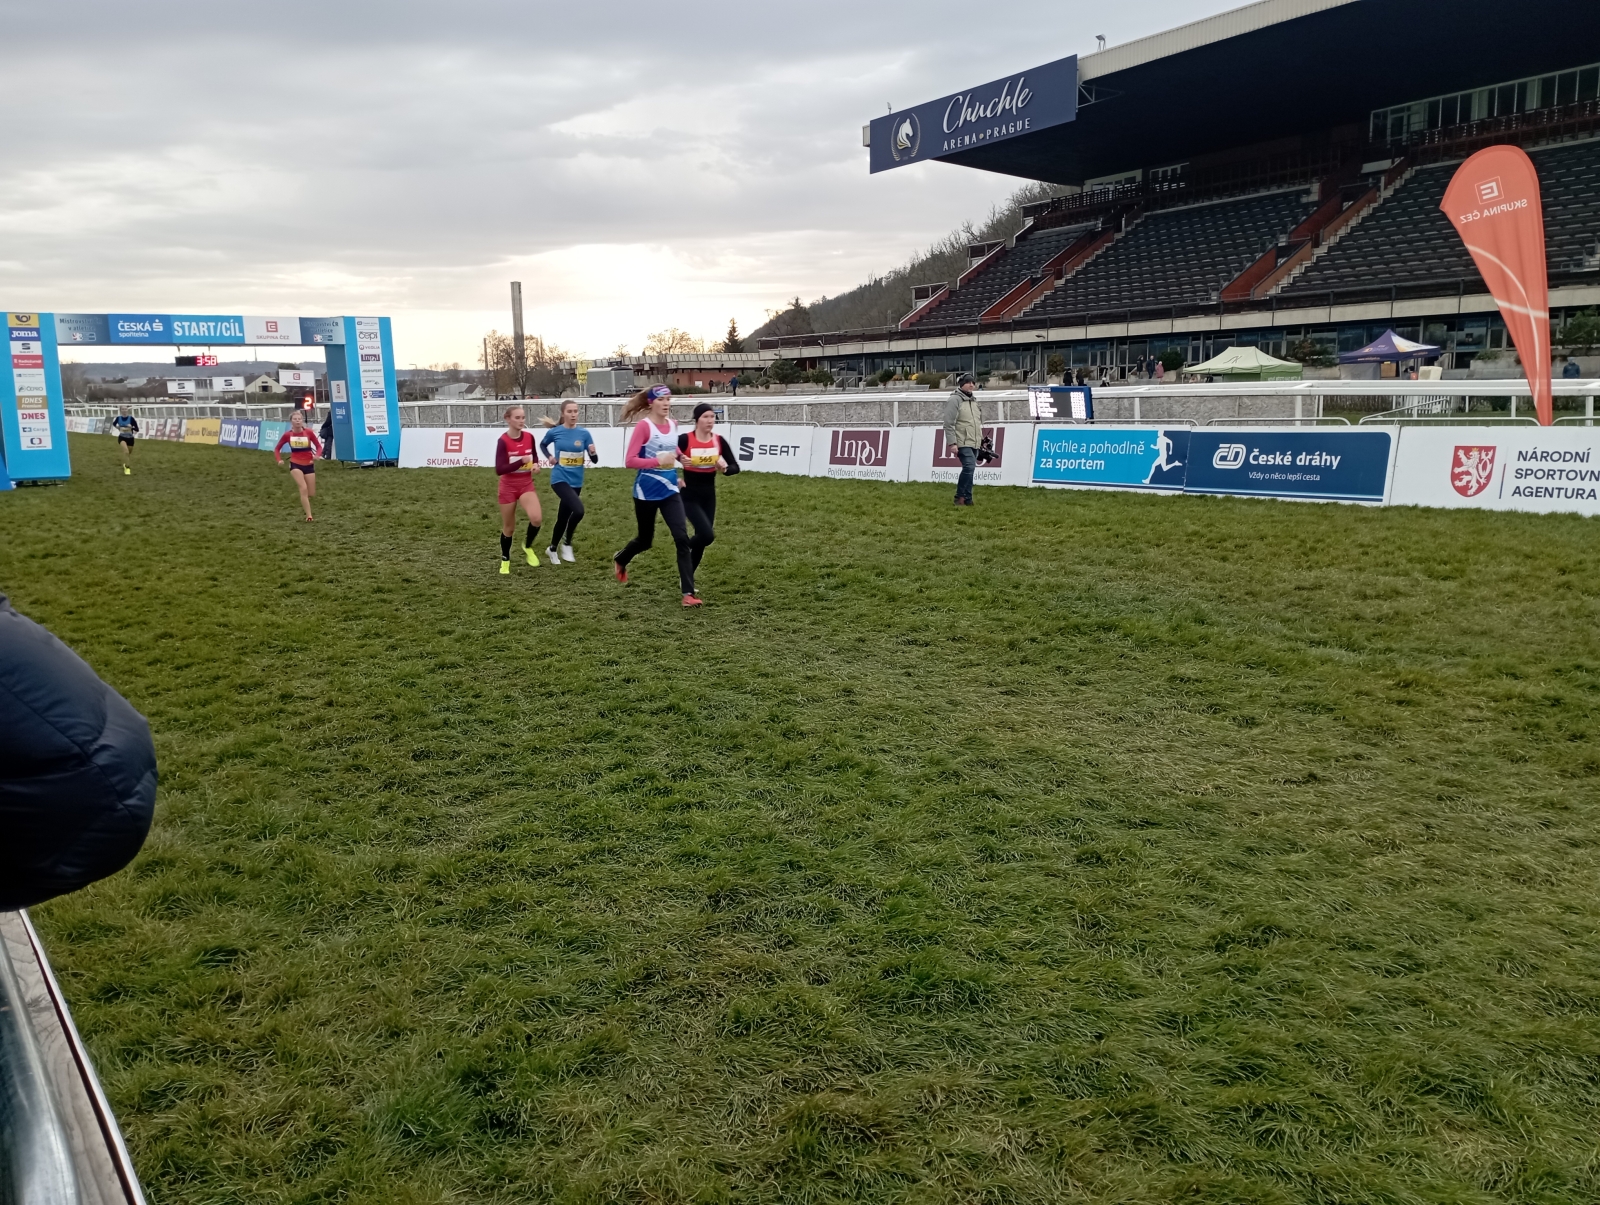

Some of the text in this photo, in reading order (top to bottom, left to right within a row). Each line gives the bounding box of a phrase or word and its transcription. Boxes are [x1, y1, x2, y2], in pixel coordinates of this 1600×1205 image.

[942, 76, 1033, 134] Chuchle
[942, 117, 1031, 151] ARENA PRAGUE
[118, 320, 151, 331] ČESKÁ
[173, 319, 244, 337] START/CÍL
[196, 356, 217, 366] 3:58
[21, 412, 46, 420] DNES
[758, 444, 800, 457] SEAT
[1042, 440, 1145, 457] Rychle a pohodlně
[1517, 447, 1592, 463] NÁRODNÍ
[463, 456, 478, 466] ČEZ
[1040, 458, 1105, 472] za sportem
[1249, 448, 1292, 466] České
[1296, 451, 1341, 470] dráhy
[827, 467, 887, 478] Pojišťovací makléřství
[931, 470, 1002, 481] Pojišťova akléřství
[1248, 472, 1265, 480] Vždy
[1270, 472, 1286, 480] něco
[1287, 472, 1302, 482] lepší
[1514, 468, 1600, 481] SPORTOVN
[1511, 486, 1598, 500] AGENTURA
